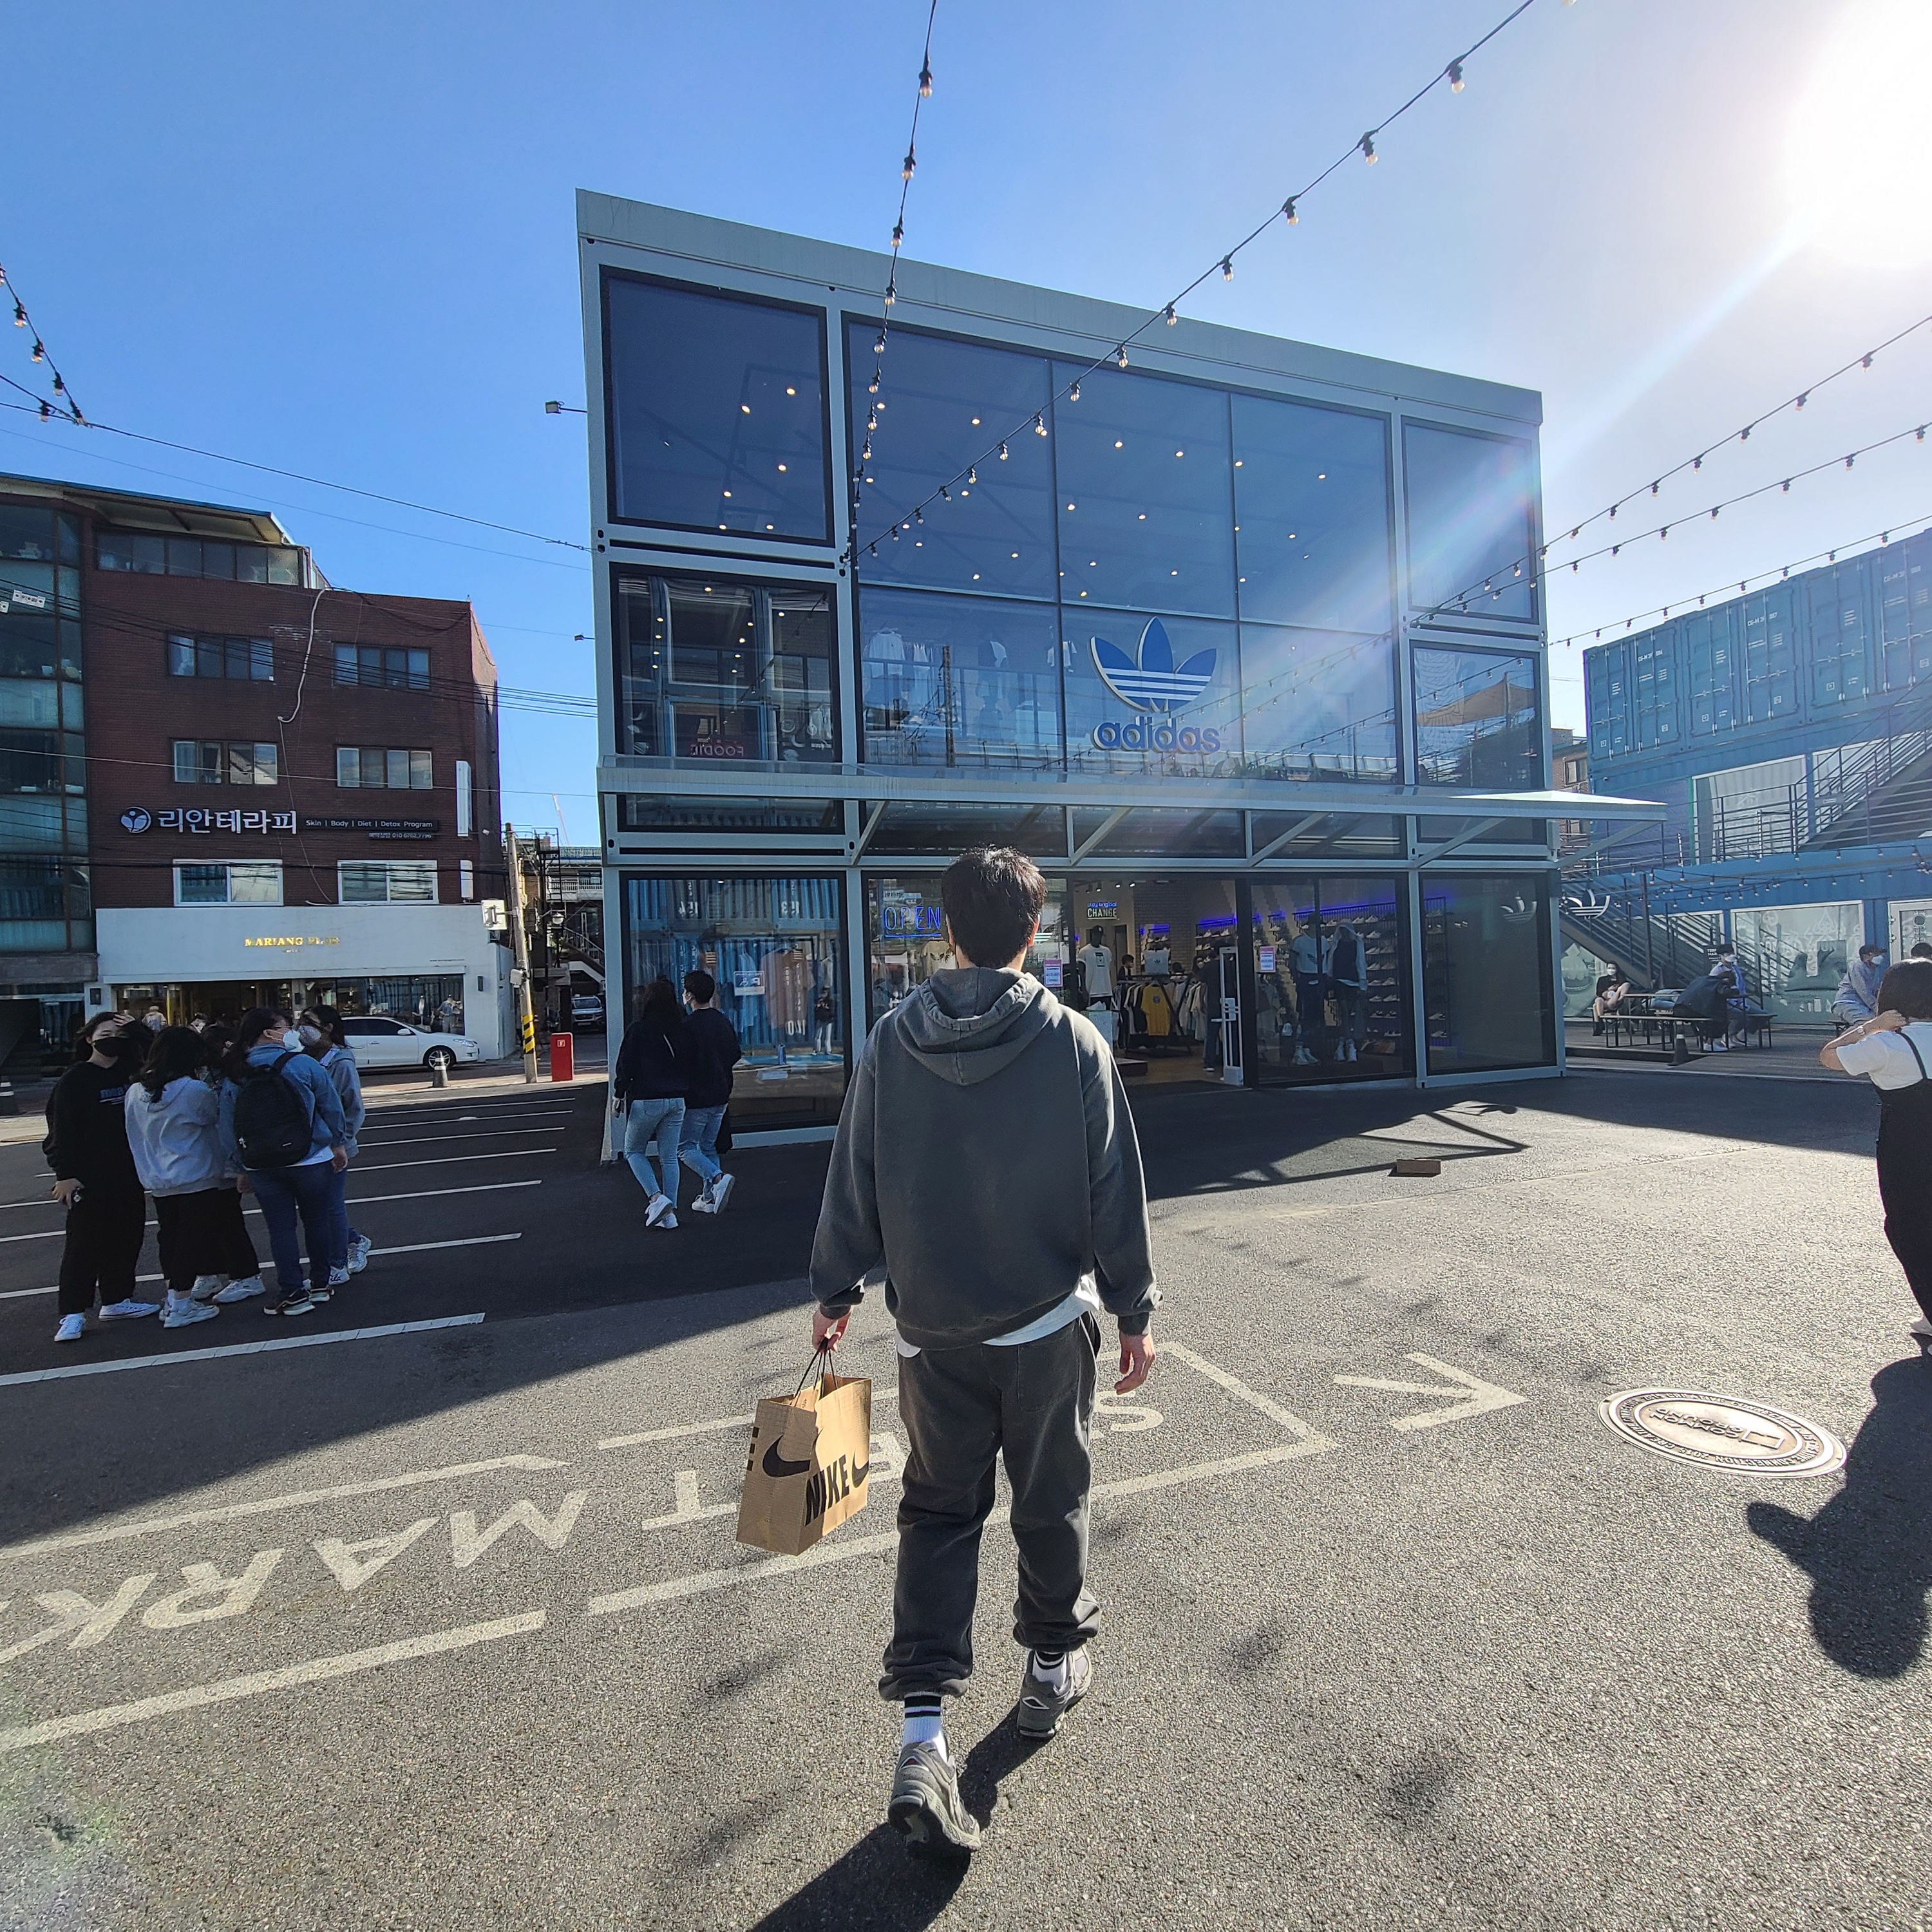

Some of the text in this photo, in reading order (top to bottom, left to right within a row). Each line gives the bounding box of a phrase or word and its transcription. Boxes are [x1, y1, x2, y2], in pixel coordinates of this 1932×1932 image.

[1094, 715, 1221, 755] adidas
[158, 808, 296, 835] 리안테라피
[884, 906, 941, 930] OPEN
[1087, 908, 1117, 918] CHANGE
[1649, 1412, 1740, 1439] COMMON
[1656, 1408, 1744, 1434] GROUND
[1680, 1448, 1710, 1461] 2015
[804, 1454, 850, 1527] NIKE
[0, 1490, 589, 1663] MARK
